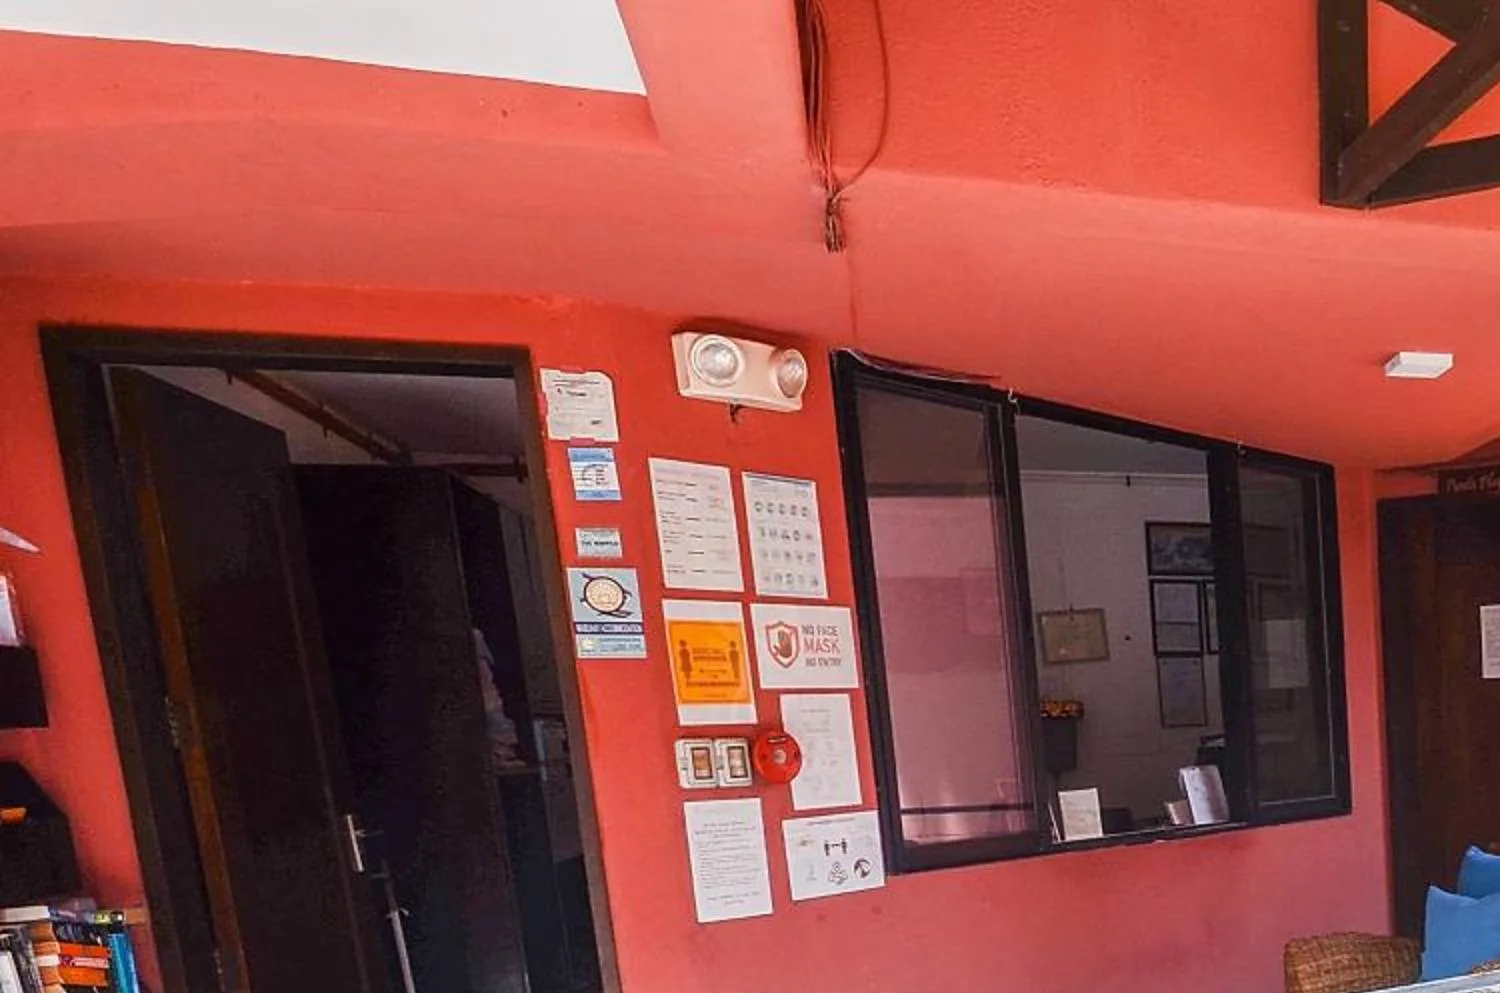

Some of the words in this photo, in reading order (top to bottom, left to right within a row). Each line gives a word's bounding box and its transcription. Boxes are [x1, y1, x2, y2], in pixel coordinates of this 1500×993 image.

[802, 624, 815, 635] NO
[817, 624, 839, 636] FACE
[804, 637, 841, 654] MASK
